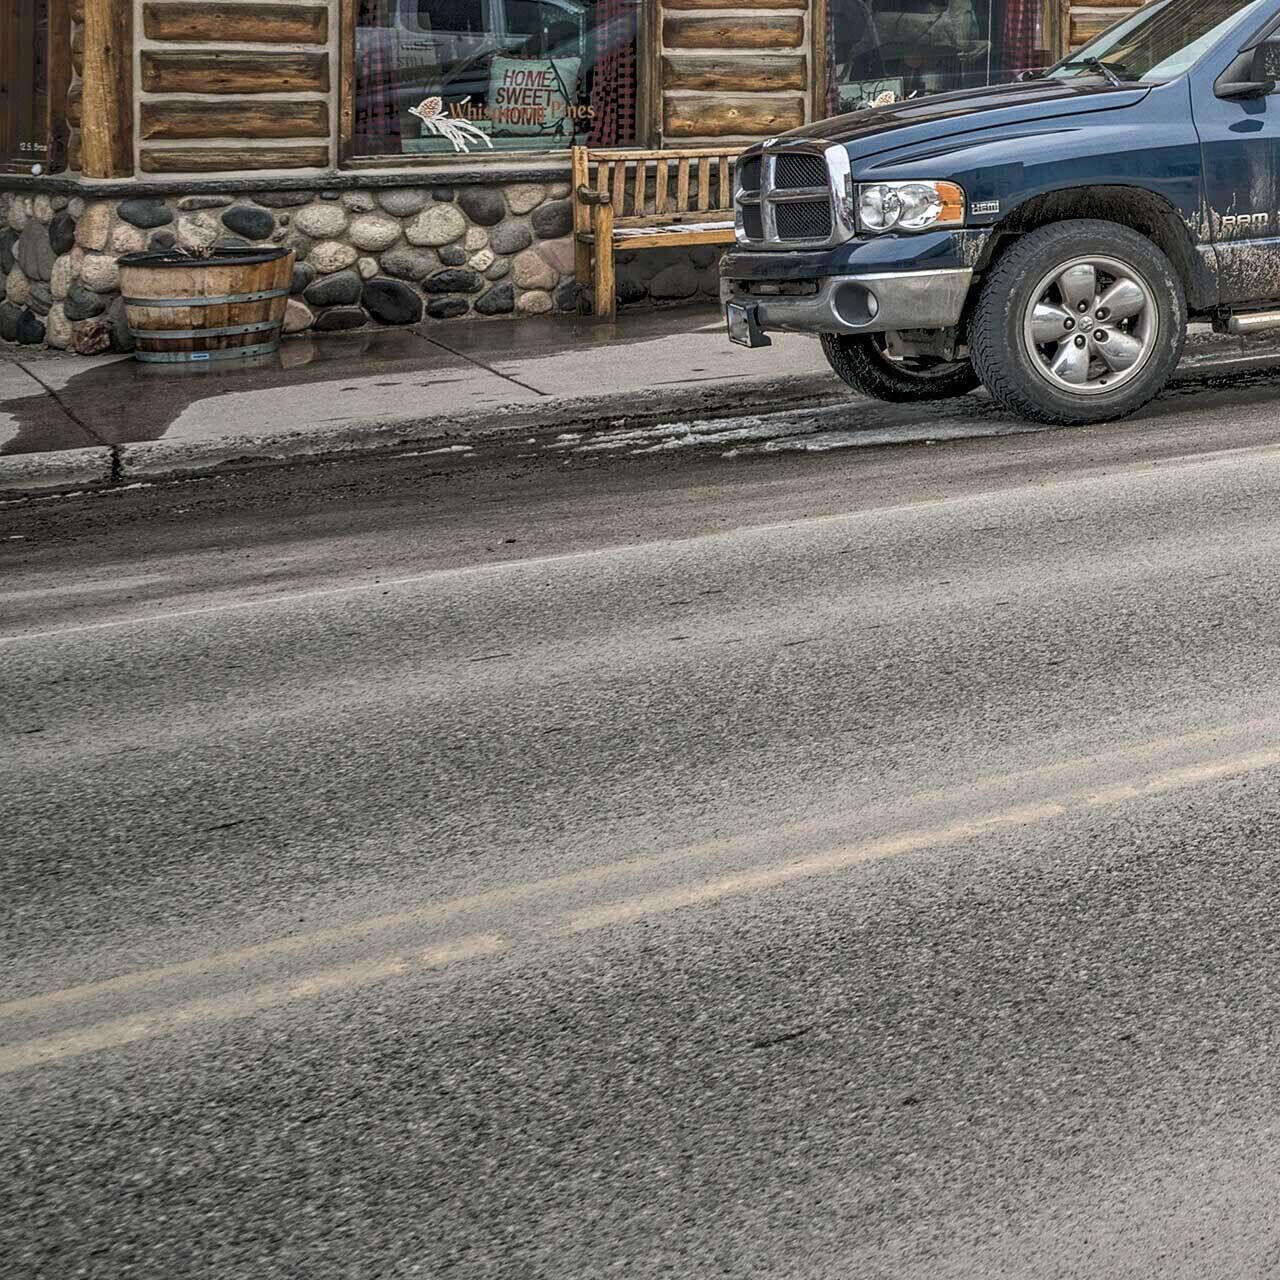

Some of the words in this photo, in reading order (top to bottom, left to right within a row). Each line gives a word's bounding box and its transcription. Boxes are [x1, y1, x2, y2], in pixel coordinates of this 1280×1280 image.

[503, 69, 554, 88] HOME
[496, 87, 554, 106] SWEET
[551, 101, 596, 120] Pines
[1222, 213, 1269, 225] RAM
